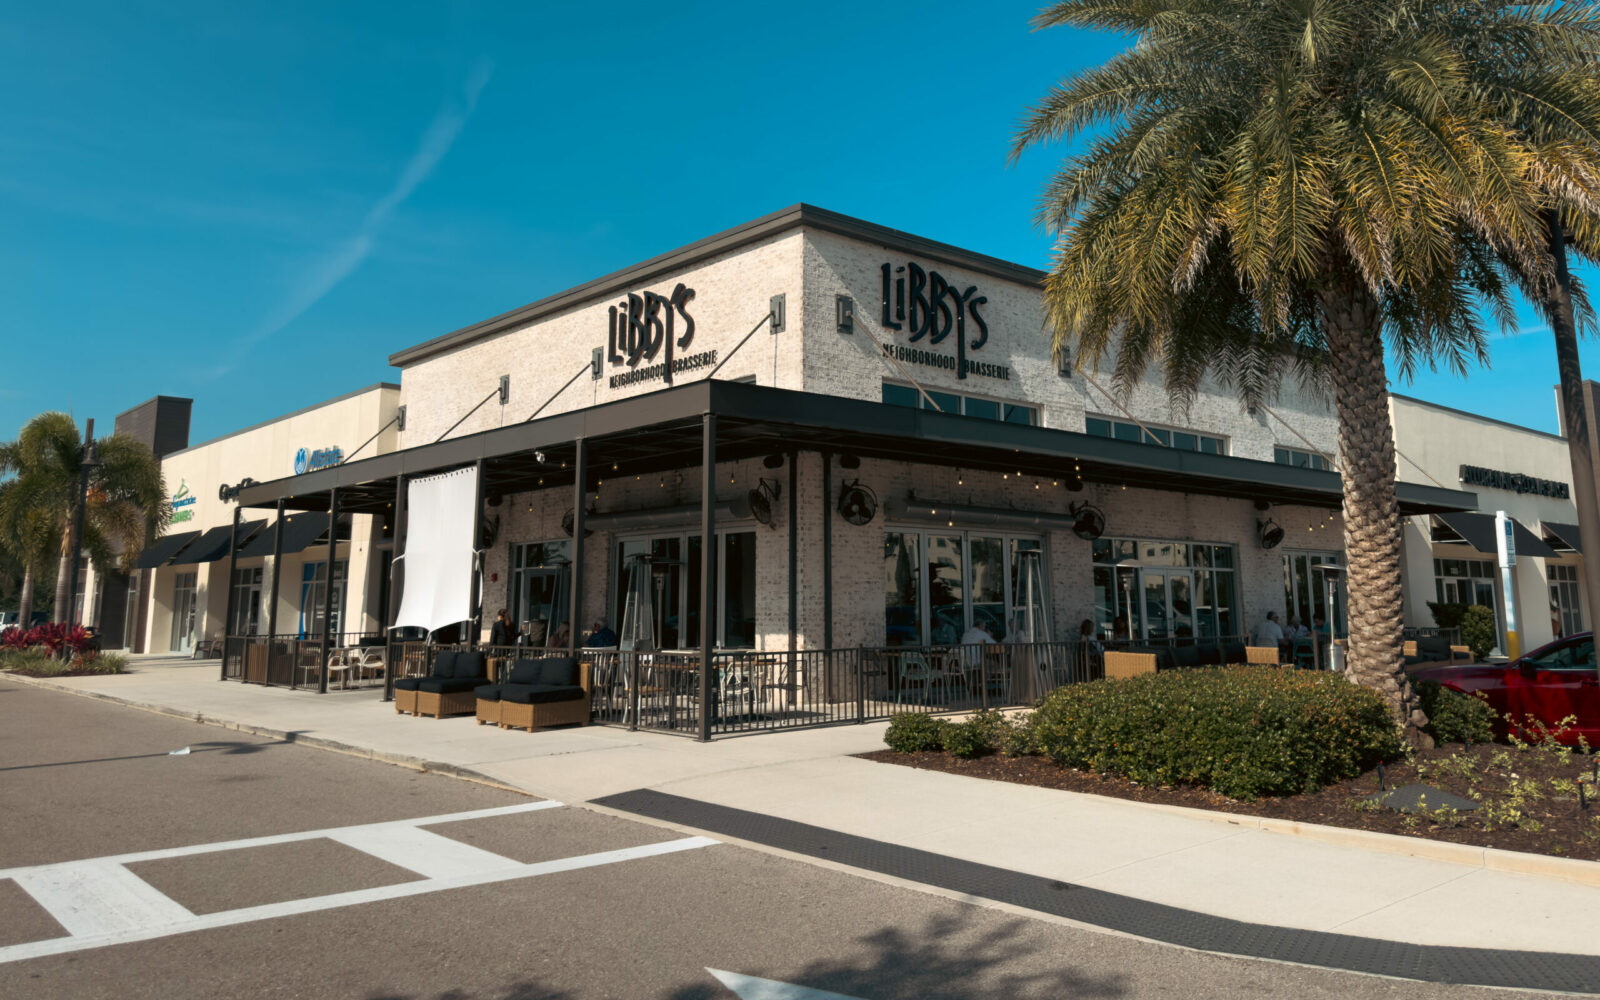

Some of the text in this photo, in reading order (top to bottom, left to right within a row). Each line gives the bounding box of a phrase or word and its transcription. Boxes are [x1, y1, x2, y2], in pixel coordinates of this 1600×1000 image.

[610, 350, 717, 389] NEIGHBORHOOD BRASSERIE
[882, 343, 1010, 380] NEIGHBORHOOD BRASSERIE
